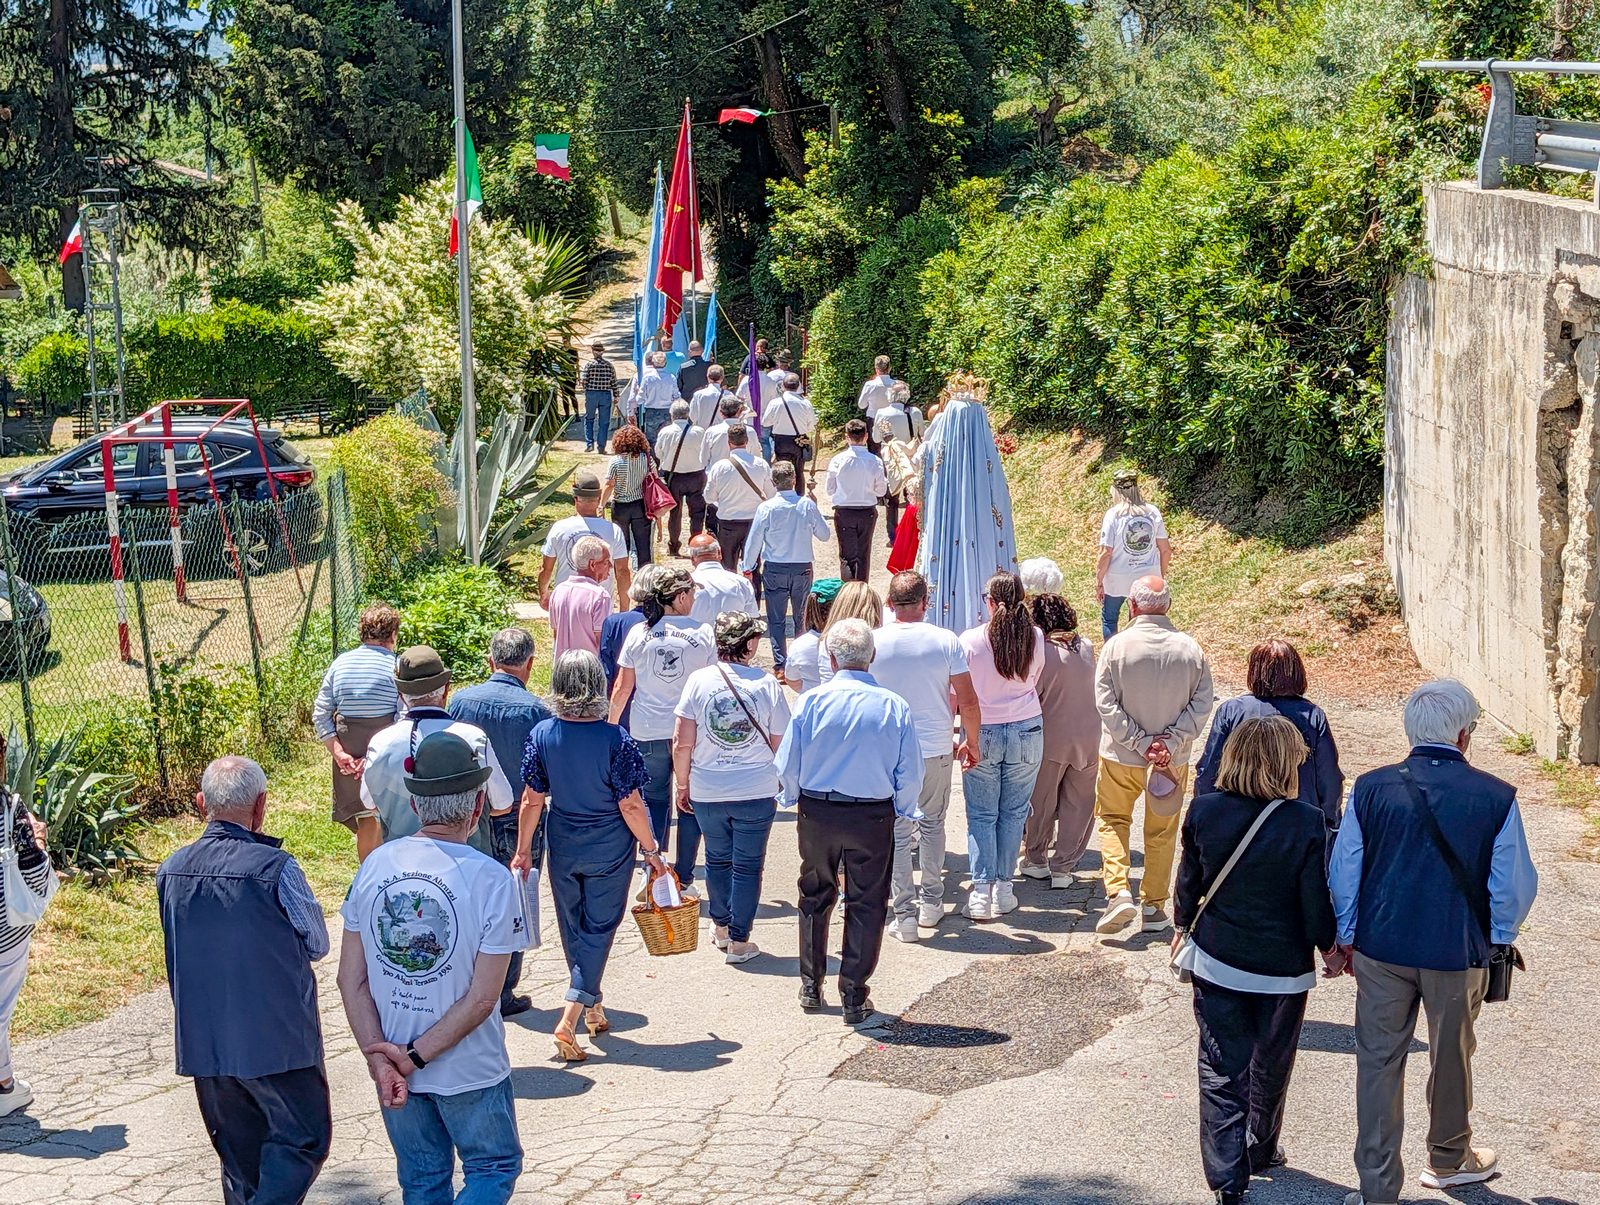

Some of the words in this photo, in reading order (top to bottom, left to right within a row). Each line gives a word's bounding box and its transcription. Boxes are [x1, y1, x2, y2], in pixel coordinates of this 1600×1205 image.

[671, 631, 700, 648] ABRUZZI
[377, 874, 401, 892] A.N.A.
[402, 870, 433, 880] Sezione
[432, 876, 458, 902] Abruzzi
